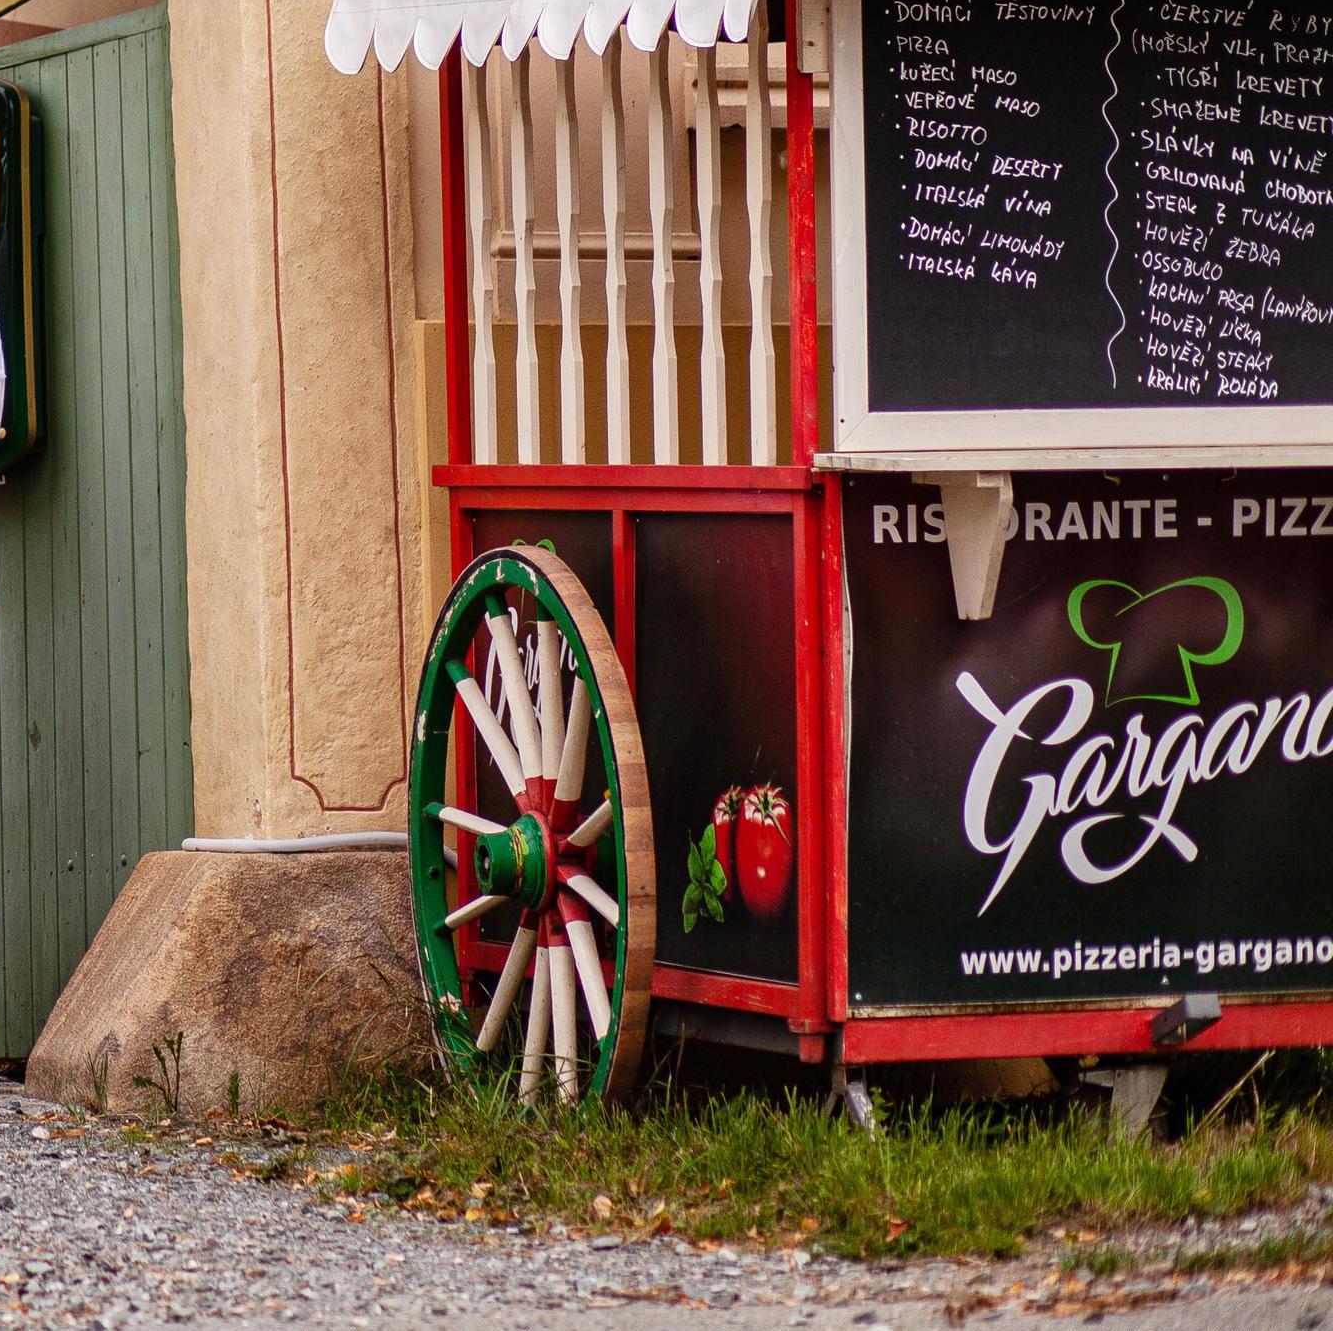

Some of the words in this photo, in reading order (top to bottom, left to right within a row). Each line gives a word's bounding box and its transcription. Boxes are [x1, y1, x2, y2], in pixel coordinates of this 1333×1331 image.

[1269, 10, 1332, 36] RYBY
[897, 35, 950, 55] PIZZA
[971, 66, 1018, 86] MASO
[1165, 62, 1218, 88] TYGŘÍ
[904, 83, 979, 110] VEPŘOVÉ
[995, 95, 1040, 117] MASO
[906, 116, 987, 146] RISOTTO
[914, 148, 980, 173] DOMÁCÍ
[992, 155, 1064, 181] DESERTY
[1232, 146, 1254, 166] NA
[1269, 146, 1327, 174] VÍNĚ
[1146, 161, 1245, 195] GRILOVANÁ
[1005, 189, 1052, 217] VÍNA
[908, 216, 973, 247] DOMÁCÍ
[1145, 219, 1213, 252] HOVĚZÍ
[1226, 237, 1281, 267] ŽEBRA
[1142, 250, 1223, 281] OSSOBUCO
[1218, 289, 1255, 314] PRSA
[1150, 304, 1213, 338] HOVĚZÍ
[1147, 333, 1212, 367] HOVĚZÍ
[1218, 374, 1279, 399] ROLÁDA
[1233, 497, 1333, 537] PIZZ
